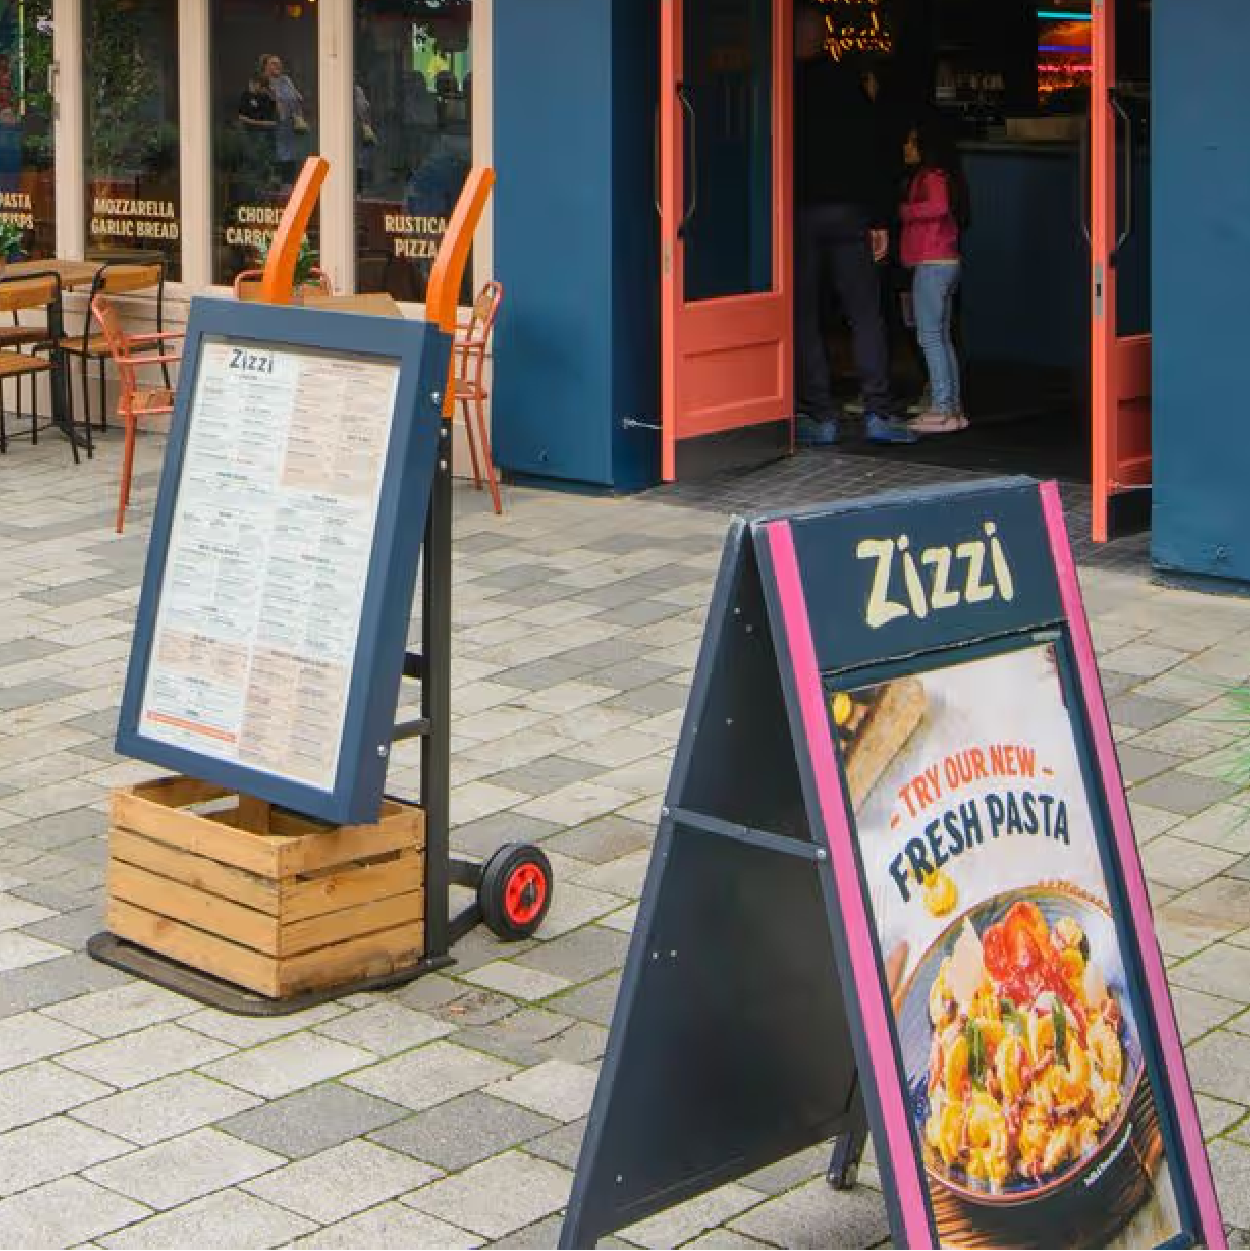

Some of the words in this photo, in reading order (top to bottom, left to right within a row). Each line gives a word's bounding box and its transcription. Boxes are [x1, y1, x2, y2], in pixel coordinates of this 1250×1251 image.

[93, 198, 174, 217] MOZZARELLA
[238, 206, 285, 224] CHORI
[91, 217, 133, 236] GARLIC
[136, 221, 179, 240] BREAD
[229, 347, 274, 374] Zizzi
[855, 521, 1015, 629] Zizzi
[899, 763, 942, 818] TRY
[944, 745, 989, 791] OUR
[989, 743, 1036, 778] NEW
[888, 799, 984, 903] FRESH
[984, 791, 1070, 846] PASTA
